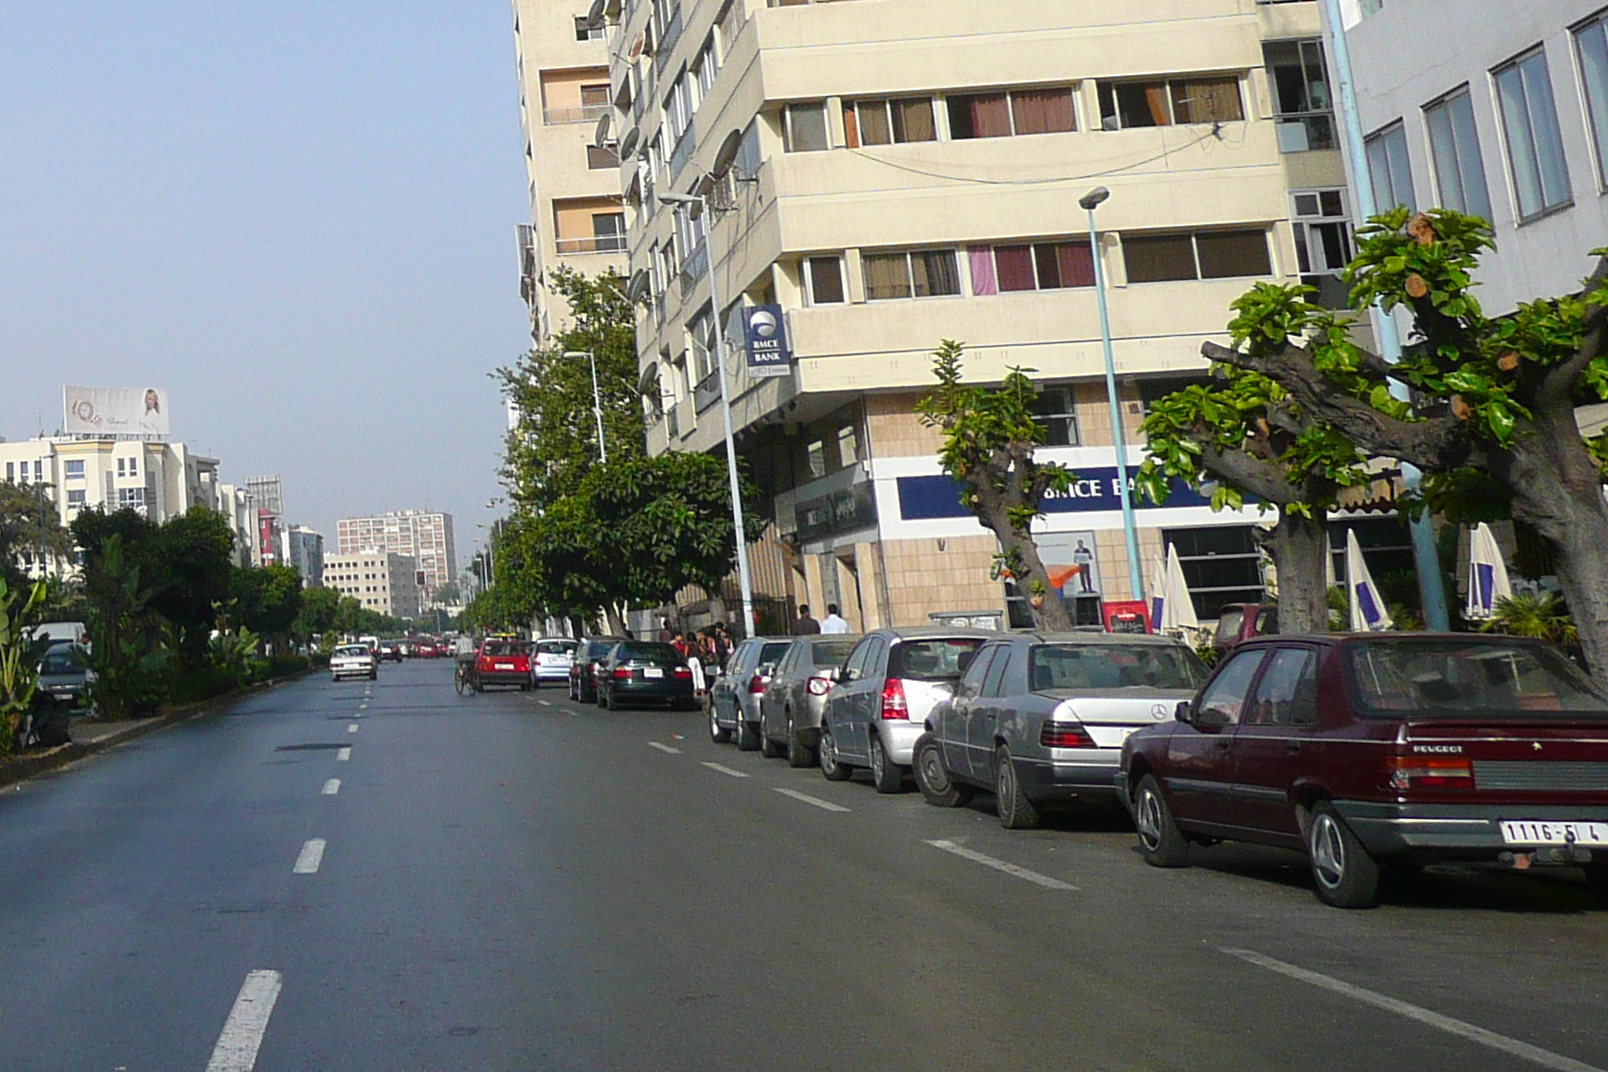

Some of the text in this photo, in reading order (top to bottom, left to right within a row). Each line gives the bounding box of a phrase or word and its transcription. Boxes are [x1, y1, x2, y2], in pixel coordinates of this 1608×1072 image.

[753, 339, 779, 349] BMCE
[754, 352, 781, 362] BANK
[1413, 745, 1462, 753] PEUGEOT
